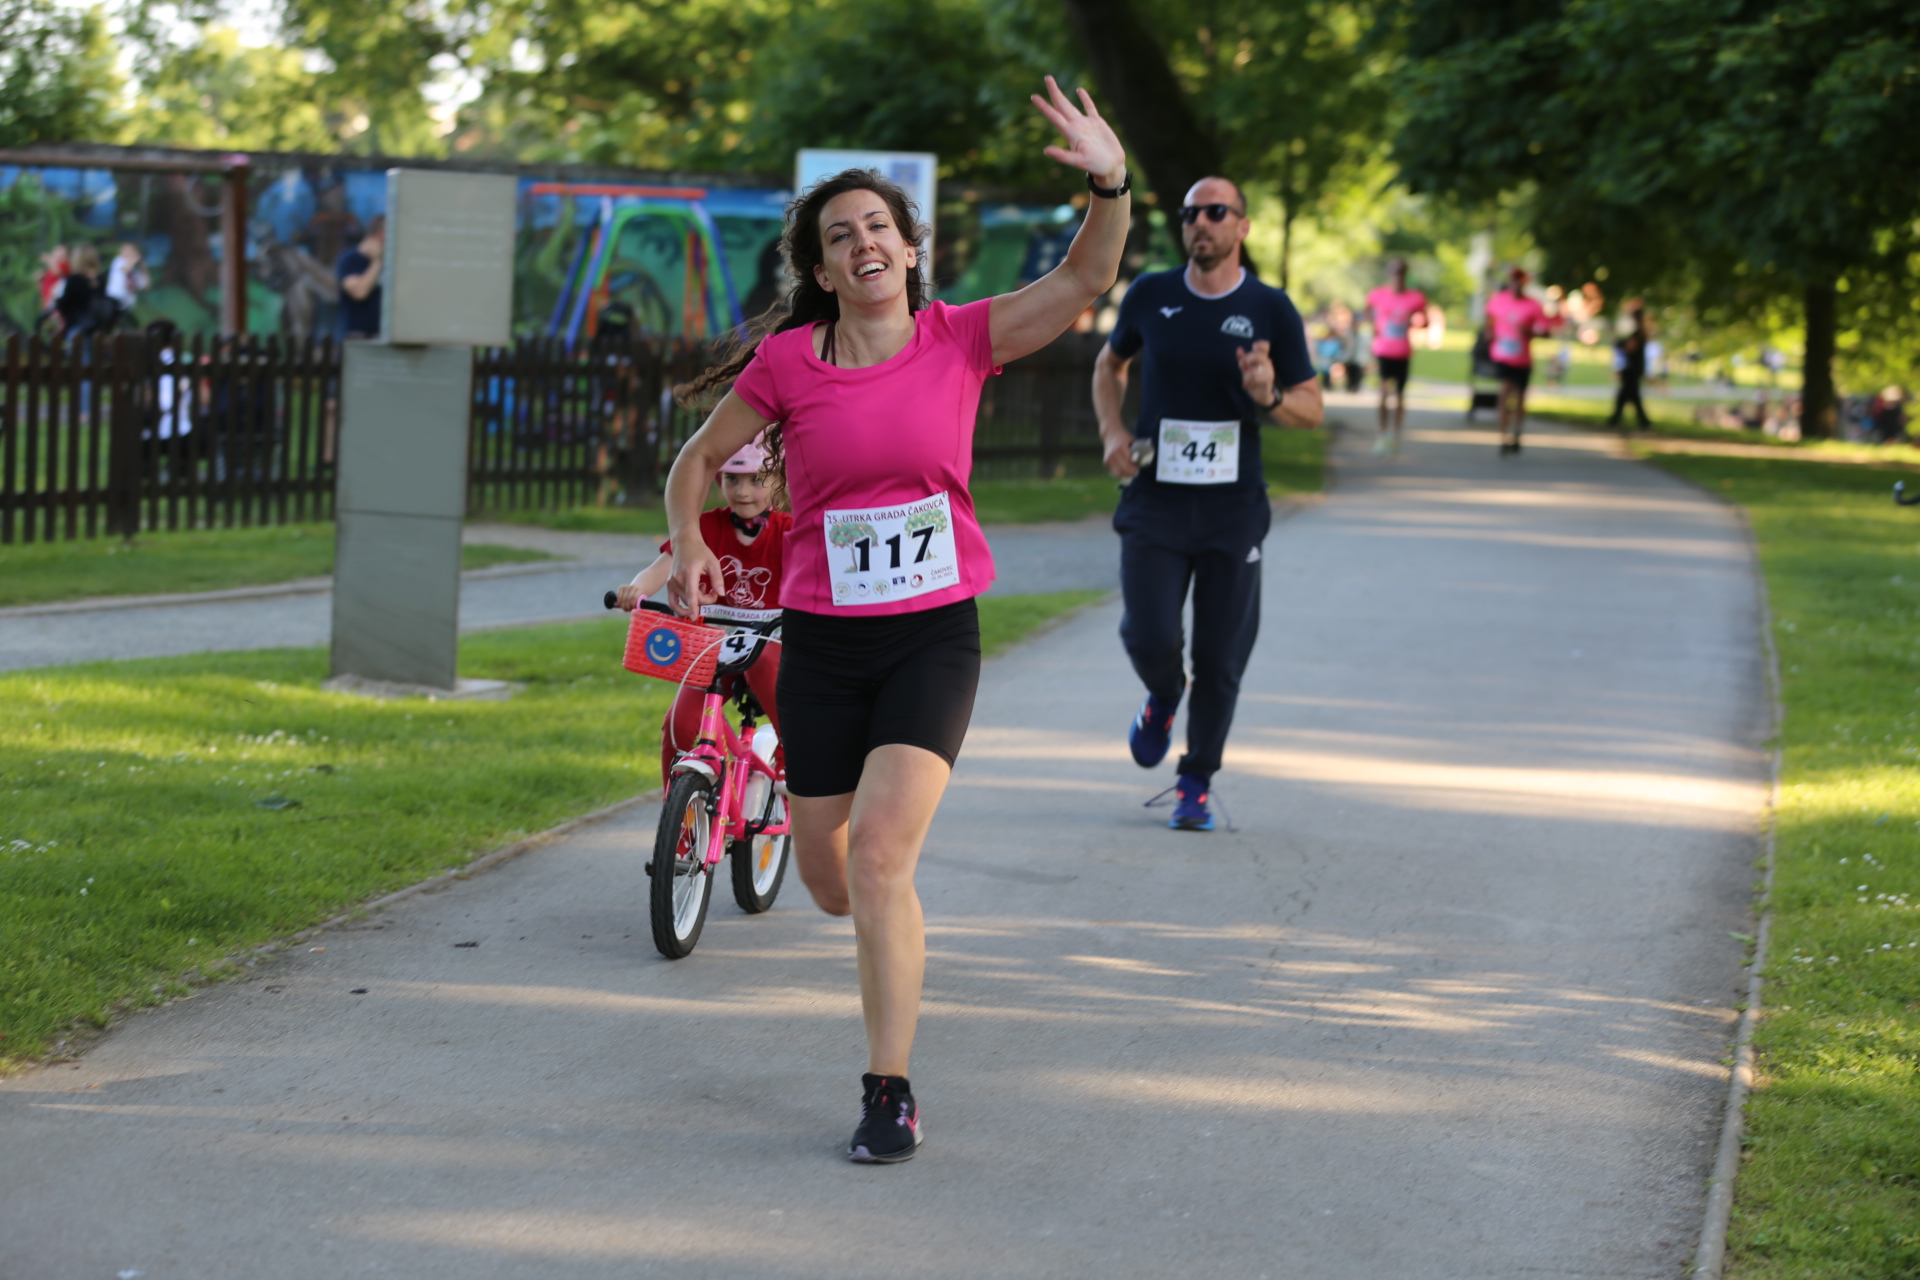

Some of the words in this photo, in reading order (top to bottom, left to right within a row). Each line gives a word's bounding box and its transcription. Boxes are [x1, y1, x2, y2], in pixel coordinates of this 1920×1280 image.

[1182, 441, 1217, 462] 44
[842, 514, 872, 523] UTRKA
[874, 510, 906, 521] GRADA
[908, 498, 944, 516] ČAKOVCA
[855, 526, 935, 572] 117
[714, 608, 736, 617] UTRKA
[737, 612, 760, 620] GRADA
